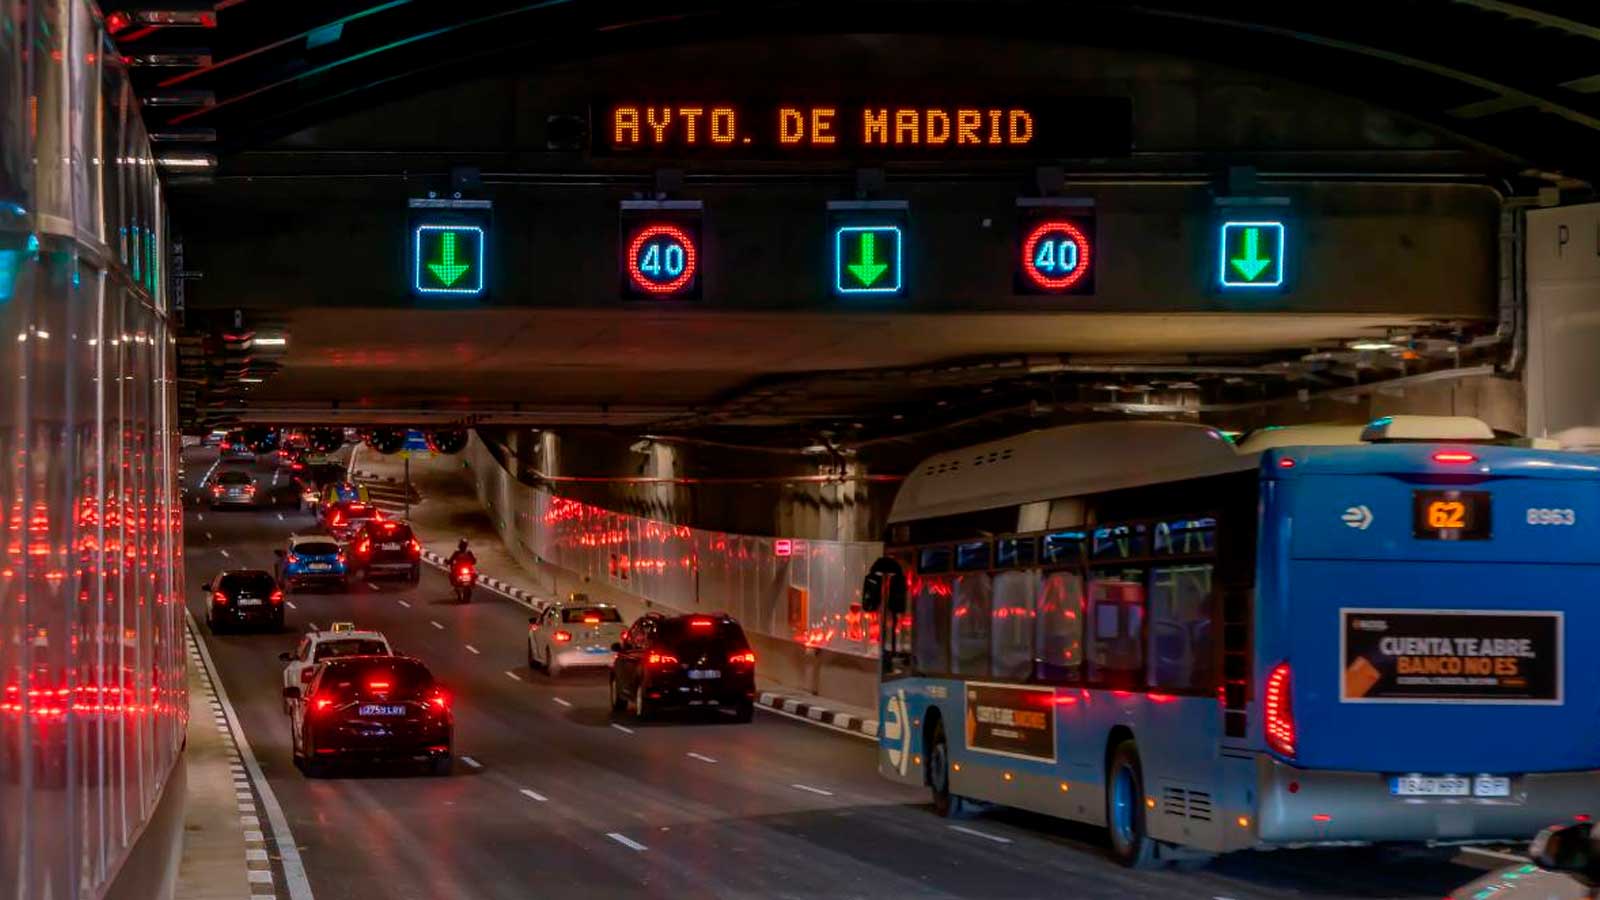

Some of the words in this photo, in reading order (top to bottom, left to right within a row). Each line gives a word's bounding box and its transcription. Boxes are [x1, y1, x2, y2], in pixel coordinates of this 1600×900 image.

[615, 108, 751, 142] AYTO.
[780, 108, 836, 143] DE
[864, 109, 1033, 143] MADRID
[641, 244, 683, 275] 40
[1034, 240, 1077, 271] 40
[1429, 502, 1465, 528] 62
[1526, 508, 1575, 526] 8963
[1379, 637, 1451, 656] CUENTA
[1452, 638, 1479, 656] TE
[1396, 656, 1461, 675] BANCO
[1464, 657, 1493, 675] NO
[1494, 658, 1518, 676] ES
